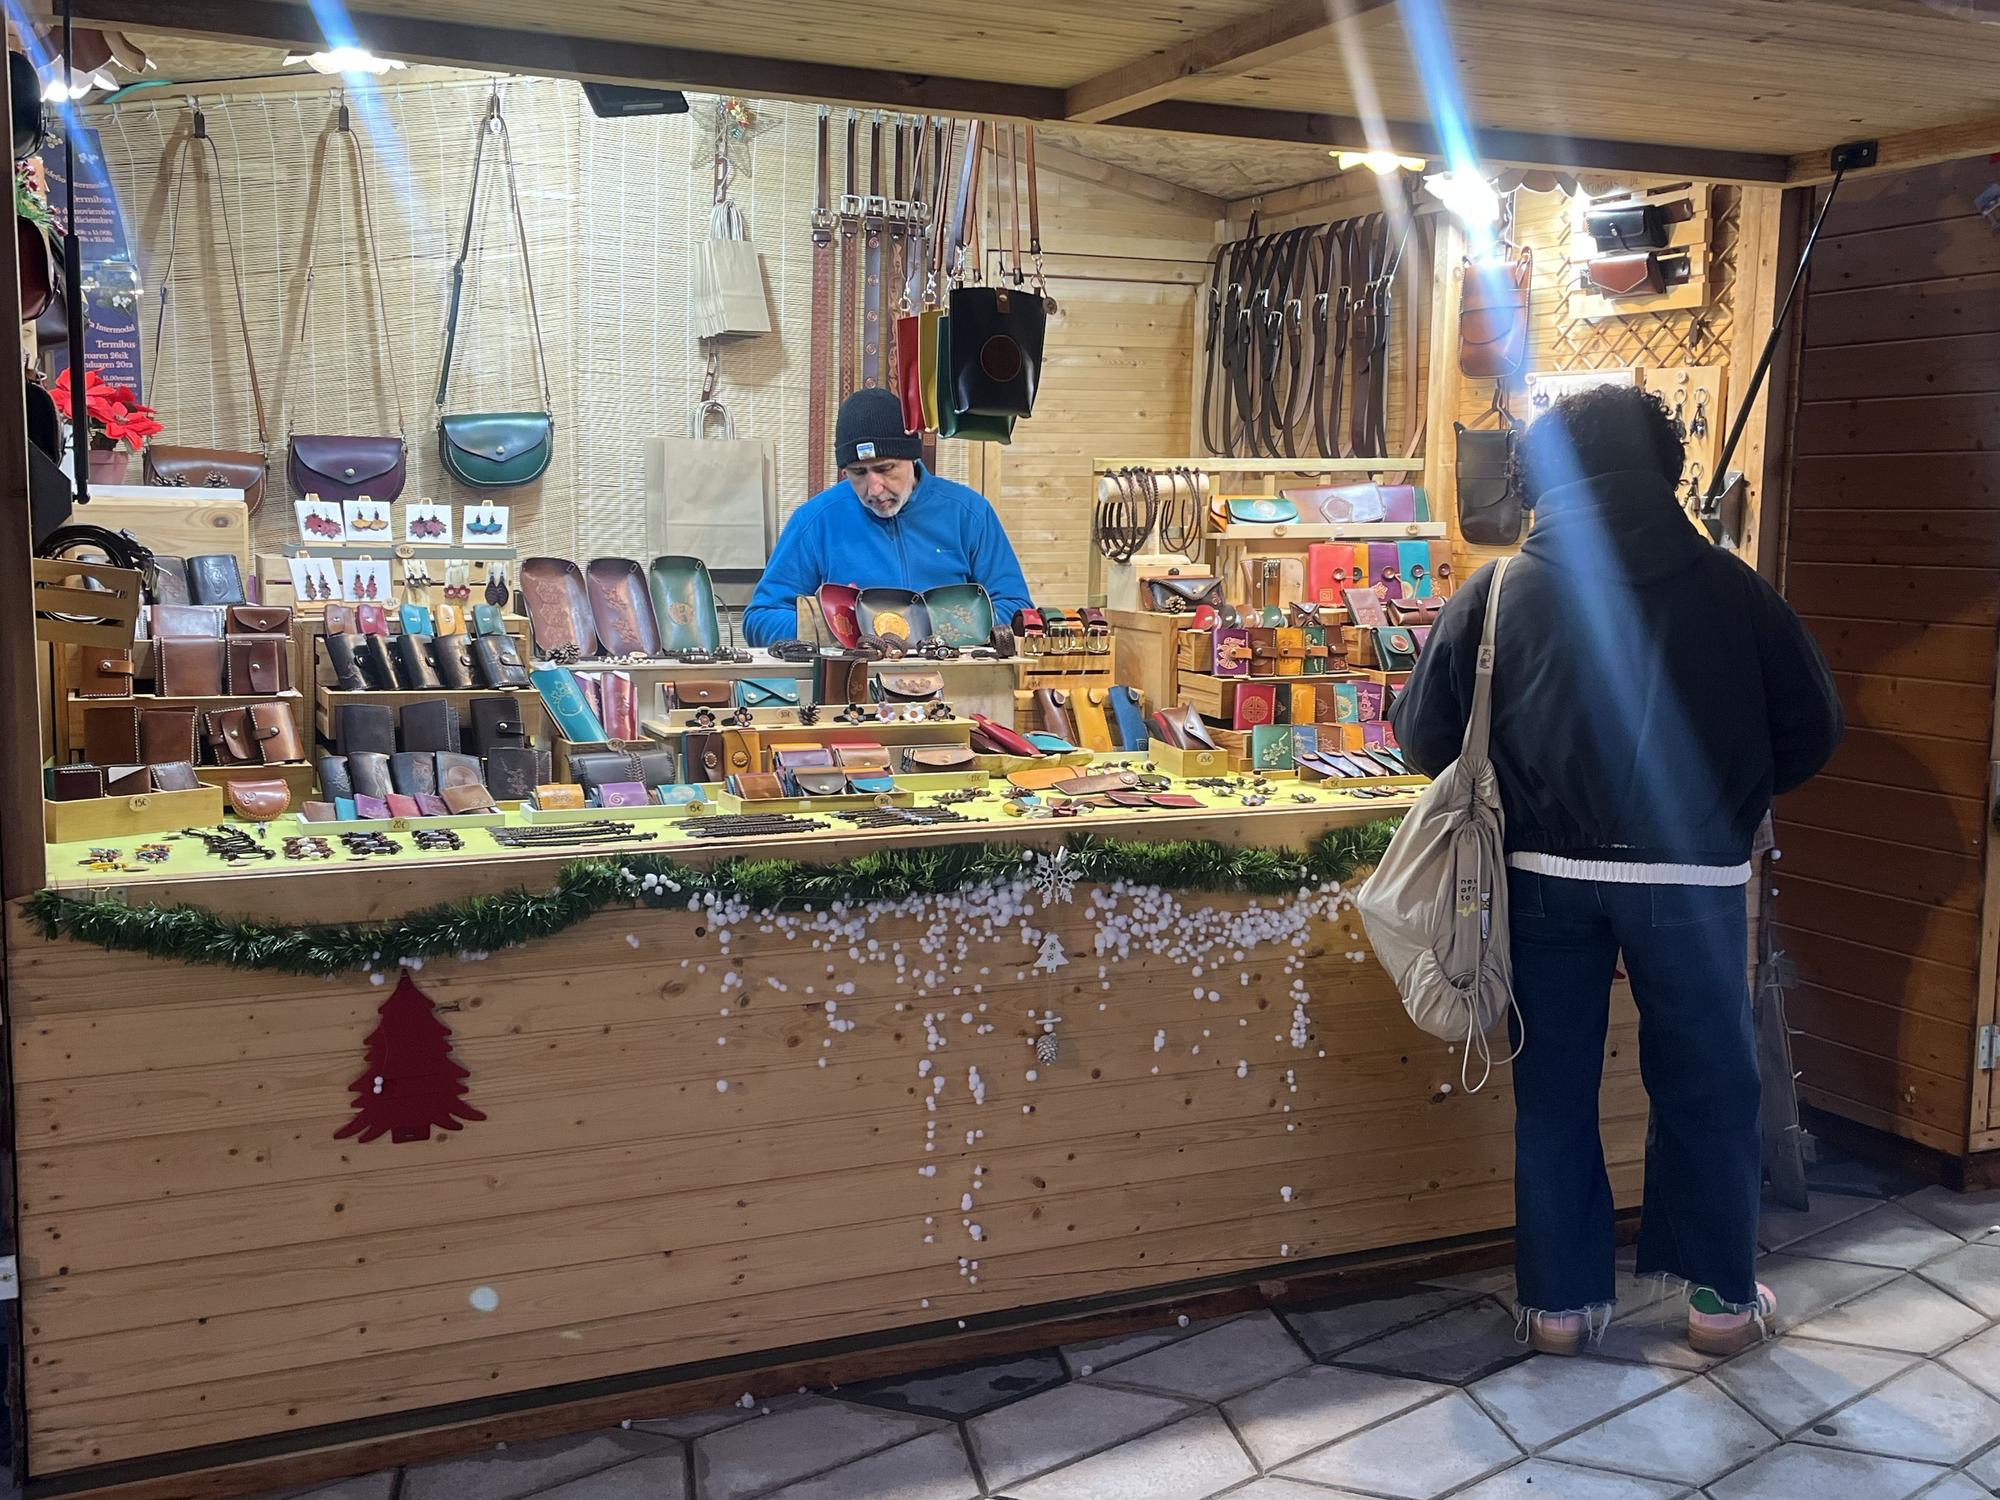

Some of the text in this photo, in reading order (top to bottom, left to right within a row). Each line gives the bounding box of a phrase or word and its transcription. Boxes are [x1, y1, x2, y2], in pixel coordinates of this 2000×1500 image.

[96, 322, 136, 334] Intermodal
[96, 340, 136, 349] Termibus
[84, 360, 115, 369] nduaren
[134, 798, 147, 808] 15€
[689, 804, 702, 812] 15€
[393, 820, 406, 829] 20€
[1460, 894, 1471, 902] to
